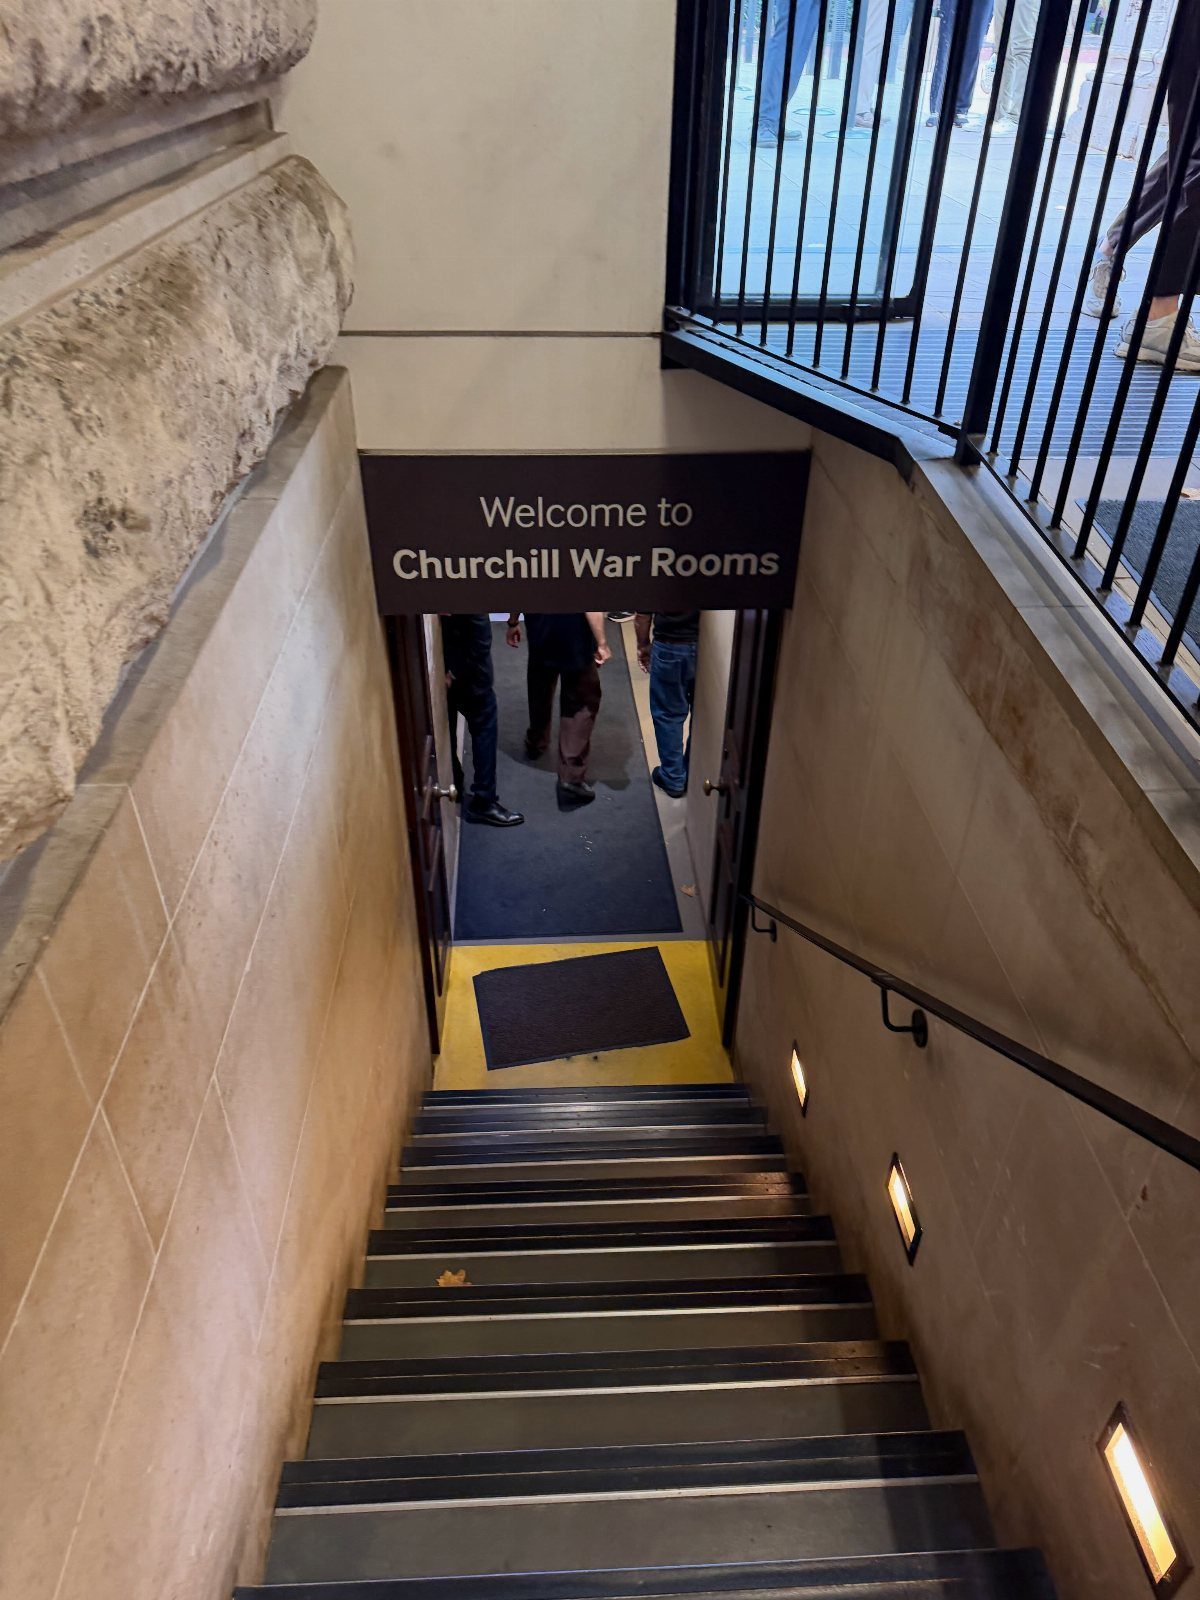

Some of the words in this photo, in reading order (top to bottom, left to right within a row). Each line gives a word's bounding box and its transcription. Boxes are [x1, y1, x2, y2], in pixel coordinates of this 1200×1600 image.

[480, 496, 647, 528] Welcome
[657, 496, 693, 527] to
[393, 548, 560, 580] Churchill
[570, 548, 641, 578] War
[651, 547, 780, 577] Rooms
